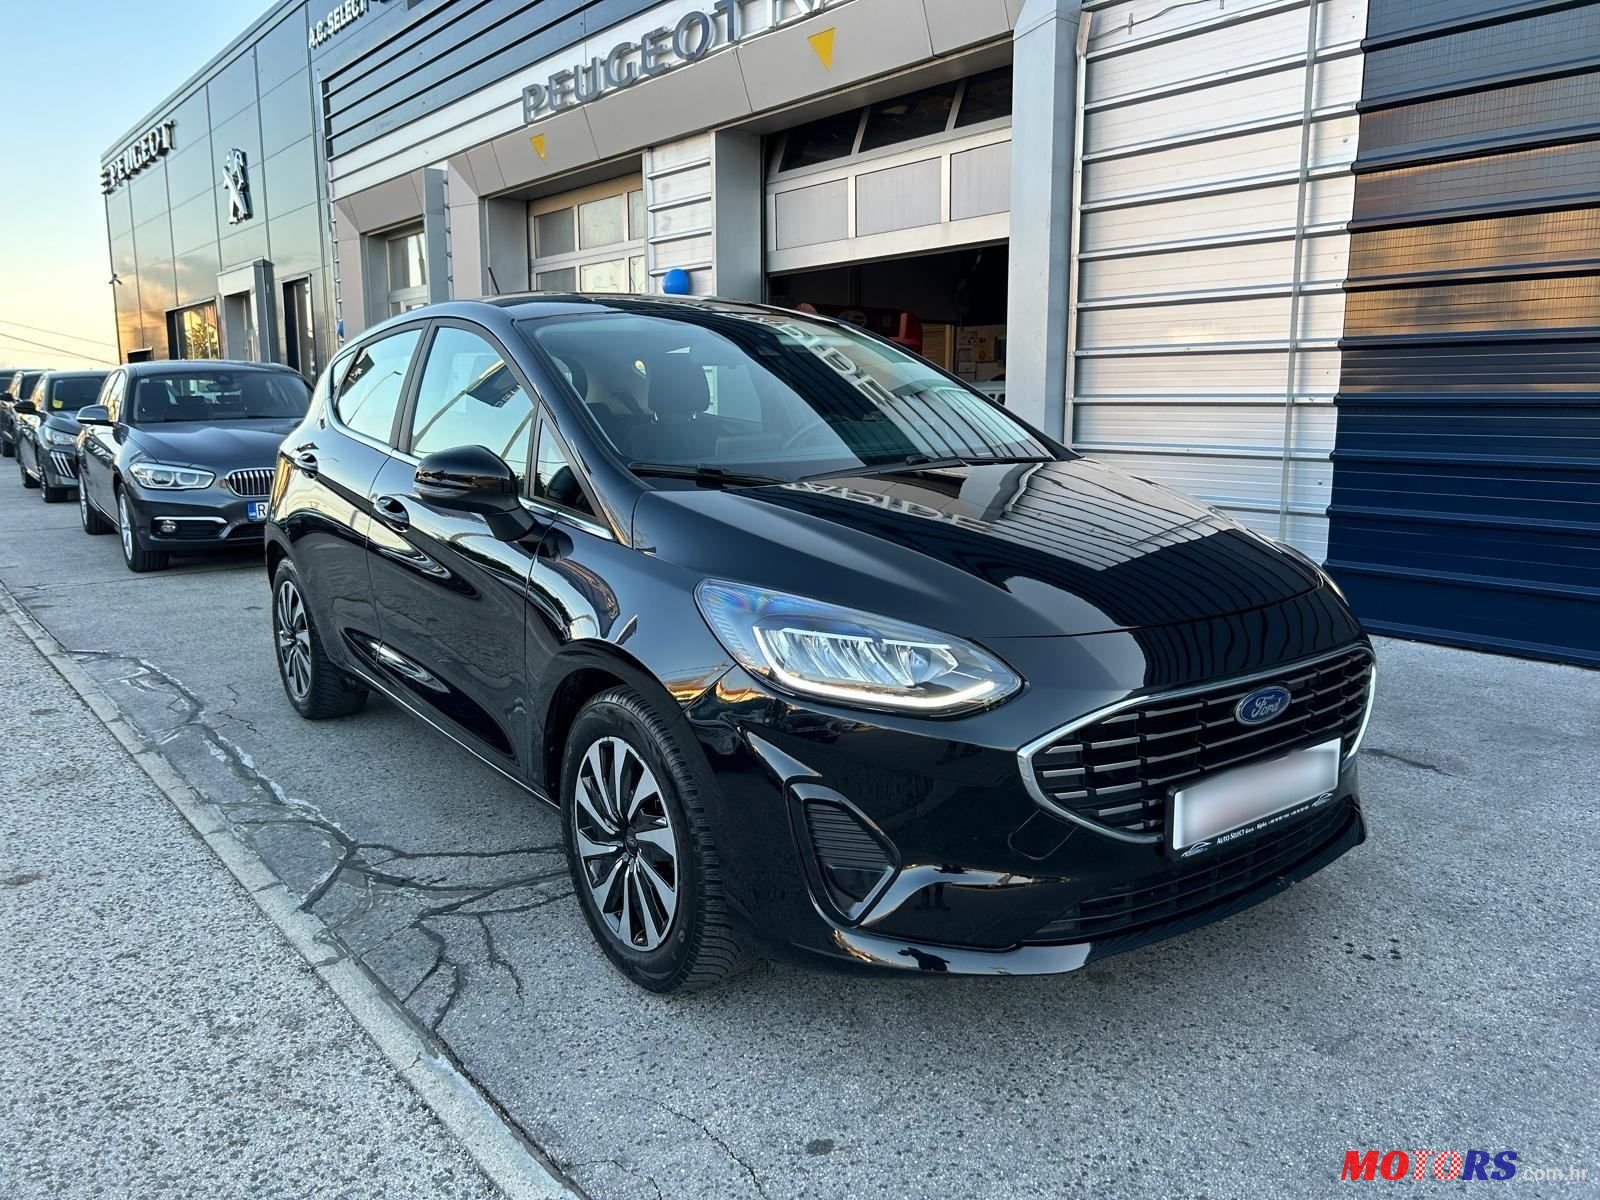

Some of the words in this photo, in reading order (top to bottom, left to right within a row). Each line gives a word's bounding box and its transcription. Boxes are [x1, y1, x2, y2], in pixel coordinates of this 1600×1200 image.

[522, 0, 741, 123] PEUGEOT
[109, 119, 176, 188] PEUGEOT
[1251, 695, 1282, 718] Ford
